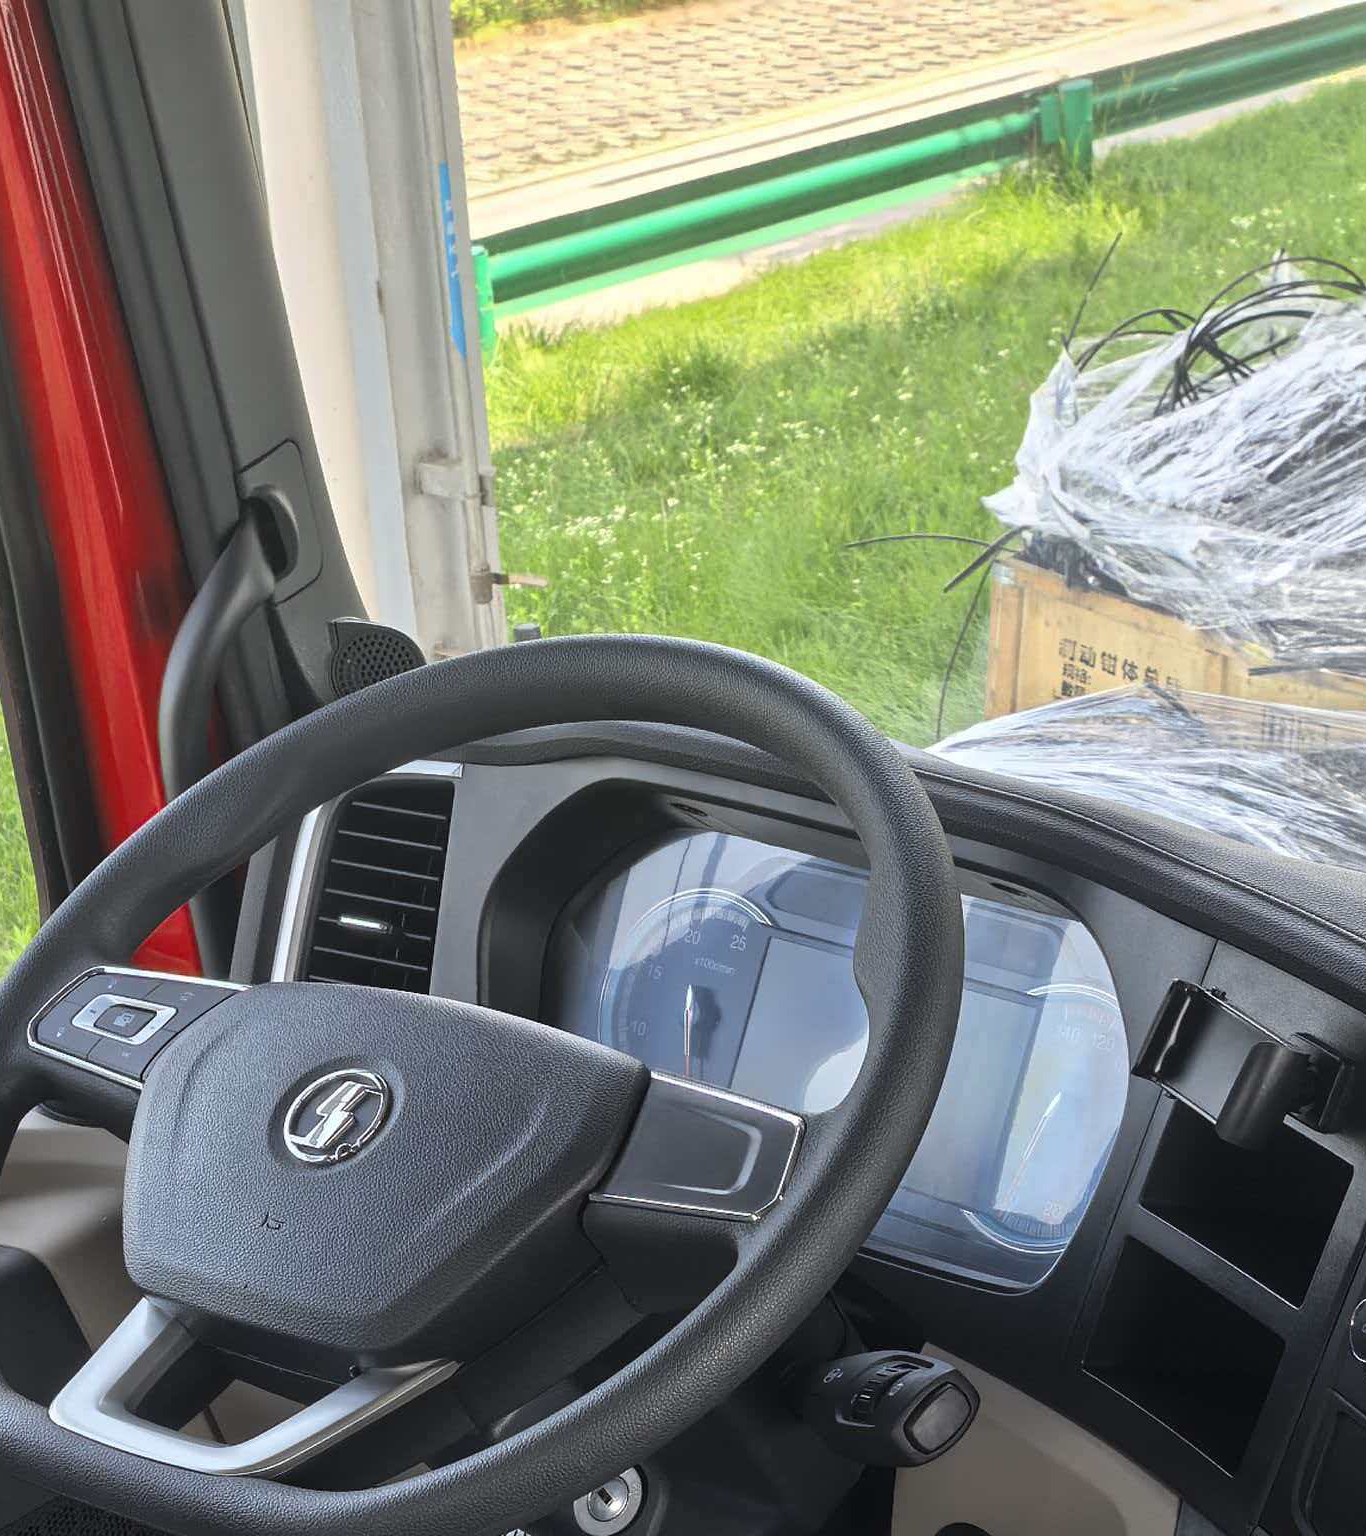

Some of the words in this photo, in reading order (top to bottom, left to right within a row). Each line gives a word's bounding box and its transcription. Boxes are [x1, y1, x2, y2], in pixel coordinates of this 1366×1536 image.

[685, 929, 701, 945] 20
[730, 934, 746, 951] 25
[647, 964, 662, 981] 15
